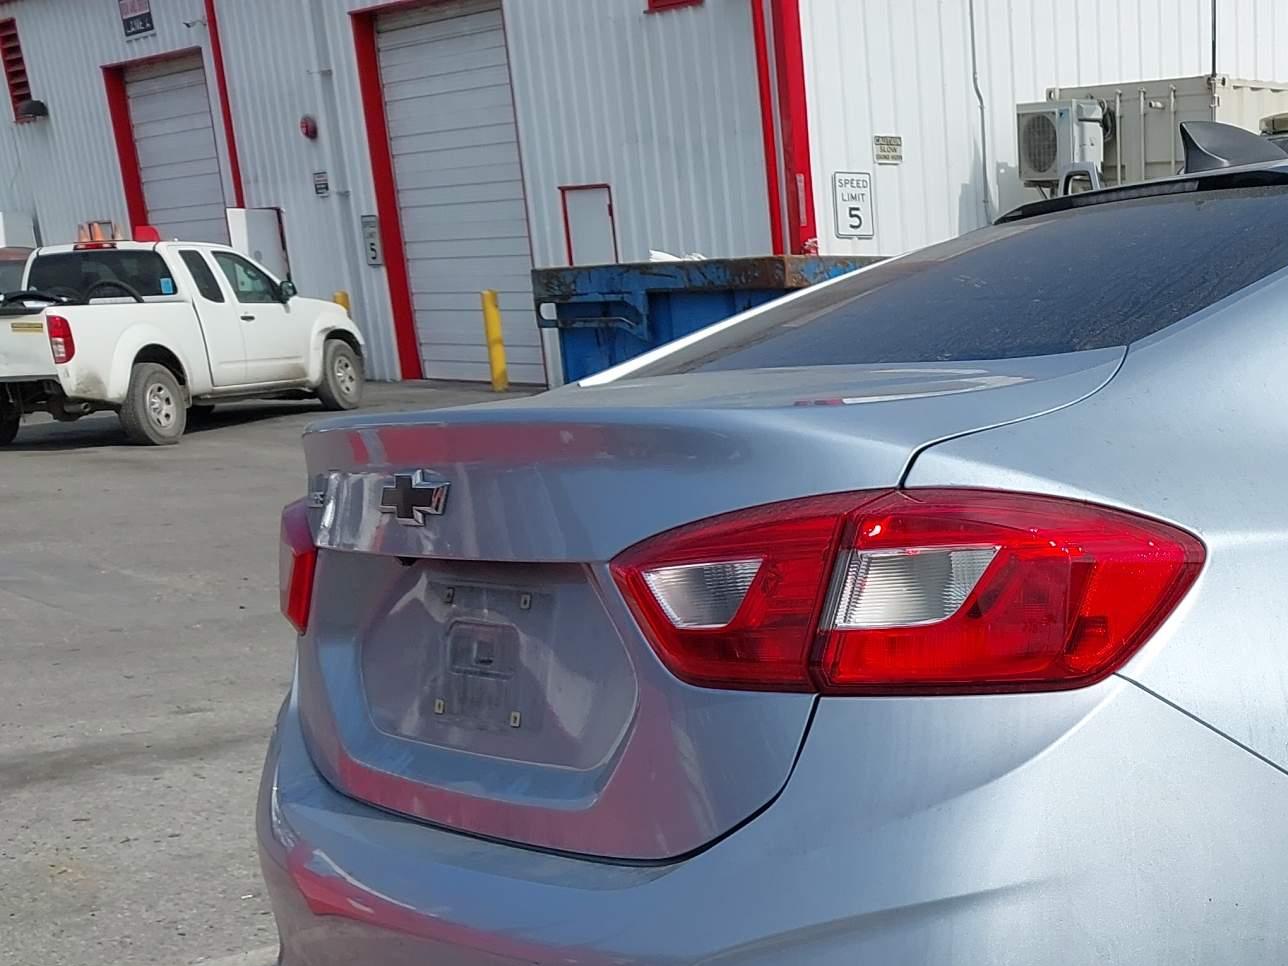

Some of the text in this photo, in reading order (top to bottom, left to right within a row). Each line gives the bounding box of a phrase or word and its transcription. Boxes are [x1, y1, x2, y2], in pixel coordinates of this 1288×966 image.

[838, 178, 868, 188] SPEED
[841, 192, 865, 202] LIMIT
[848, 206, 863, 229] 5
